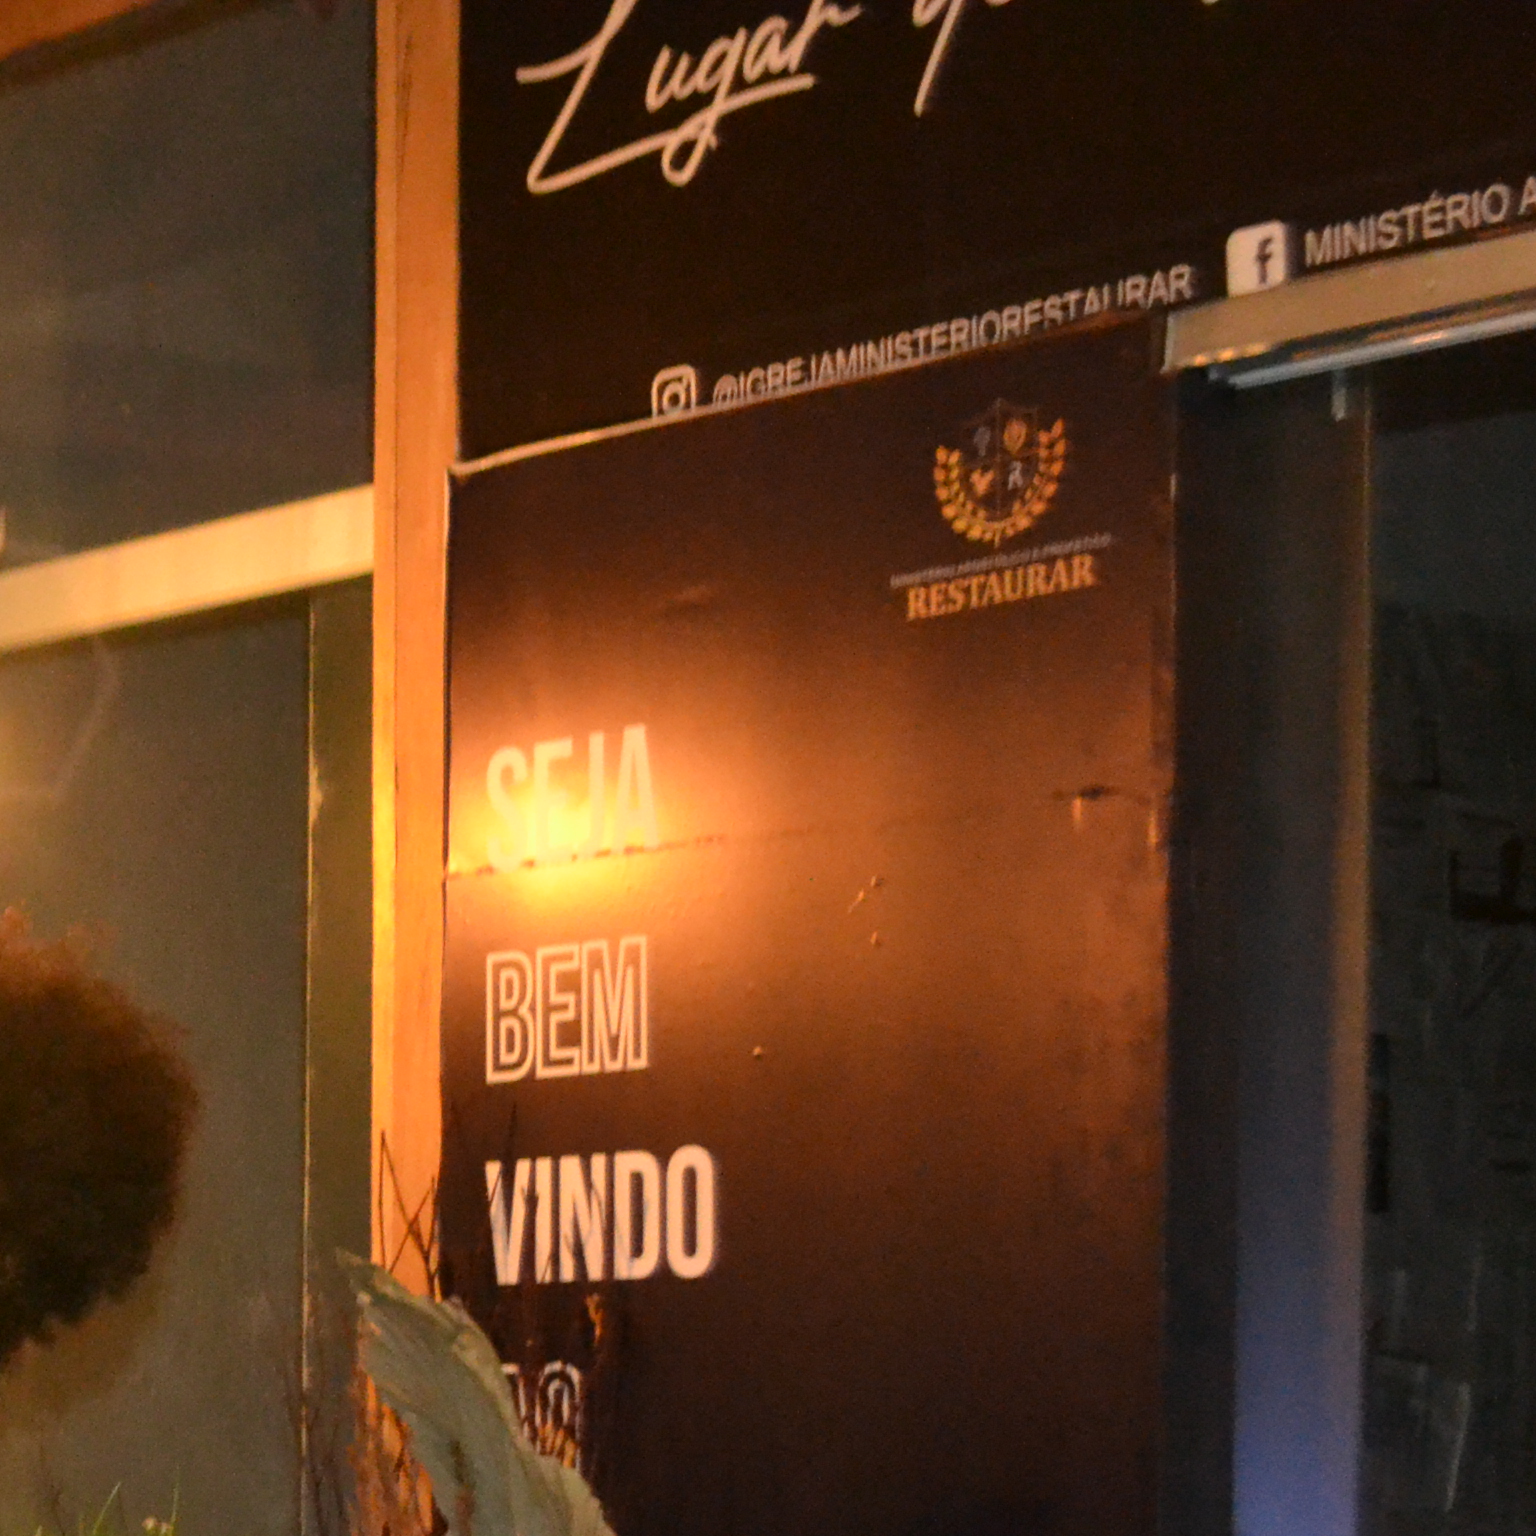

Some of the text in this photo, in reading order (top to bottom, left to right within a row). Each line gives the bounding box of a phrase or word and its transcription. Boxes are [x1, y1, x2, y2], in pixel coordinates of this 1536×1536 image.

[516, 0, 862, 194] Lugar
[1304, 182, 1511, 269] MINISTÉRIO
[906, 553, 1101, 621] RESTAURAR
[485, 723, 659, 873] SEJA
[485, 934, 649, 1085] BEM
[485, 1144, 718, 1286] VINDO
